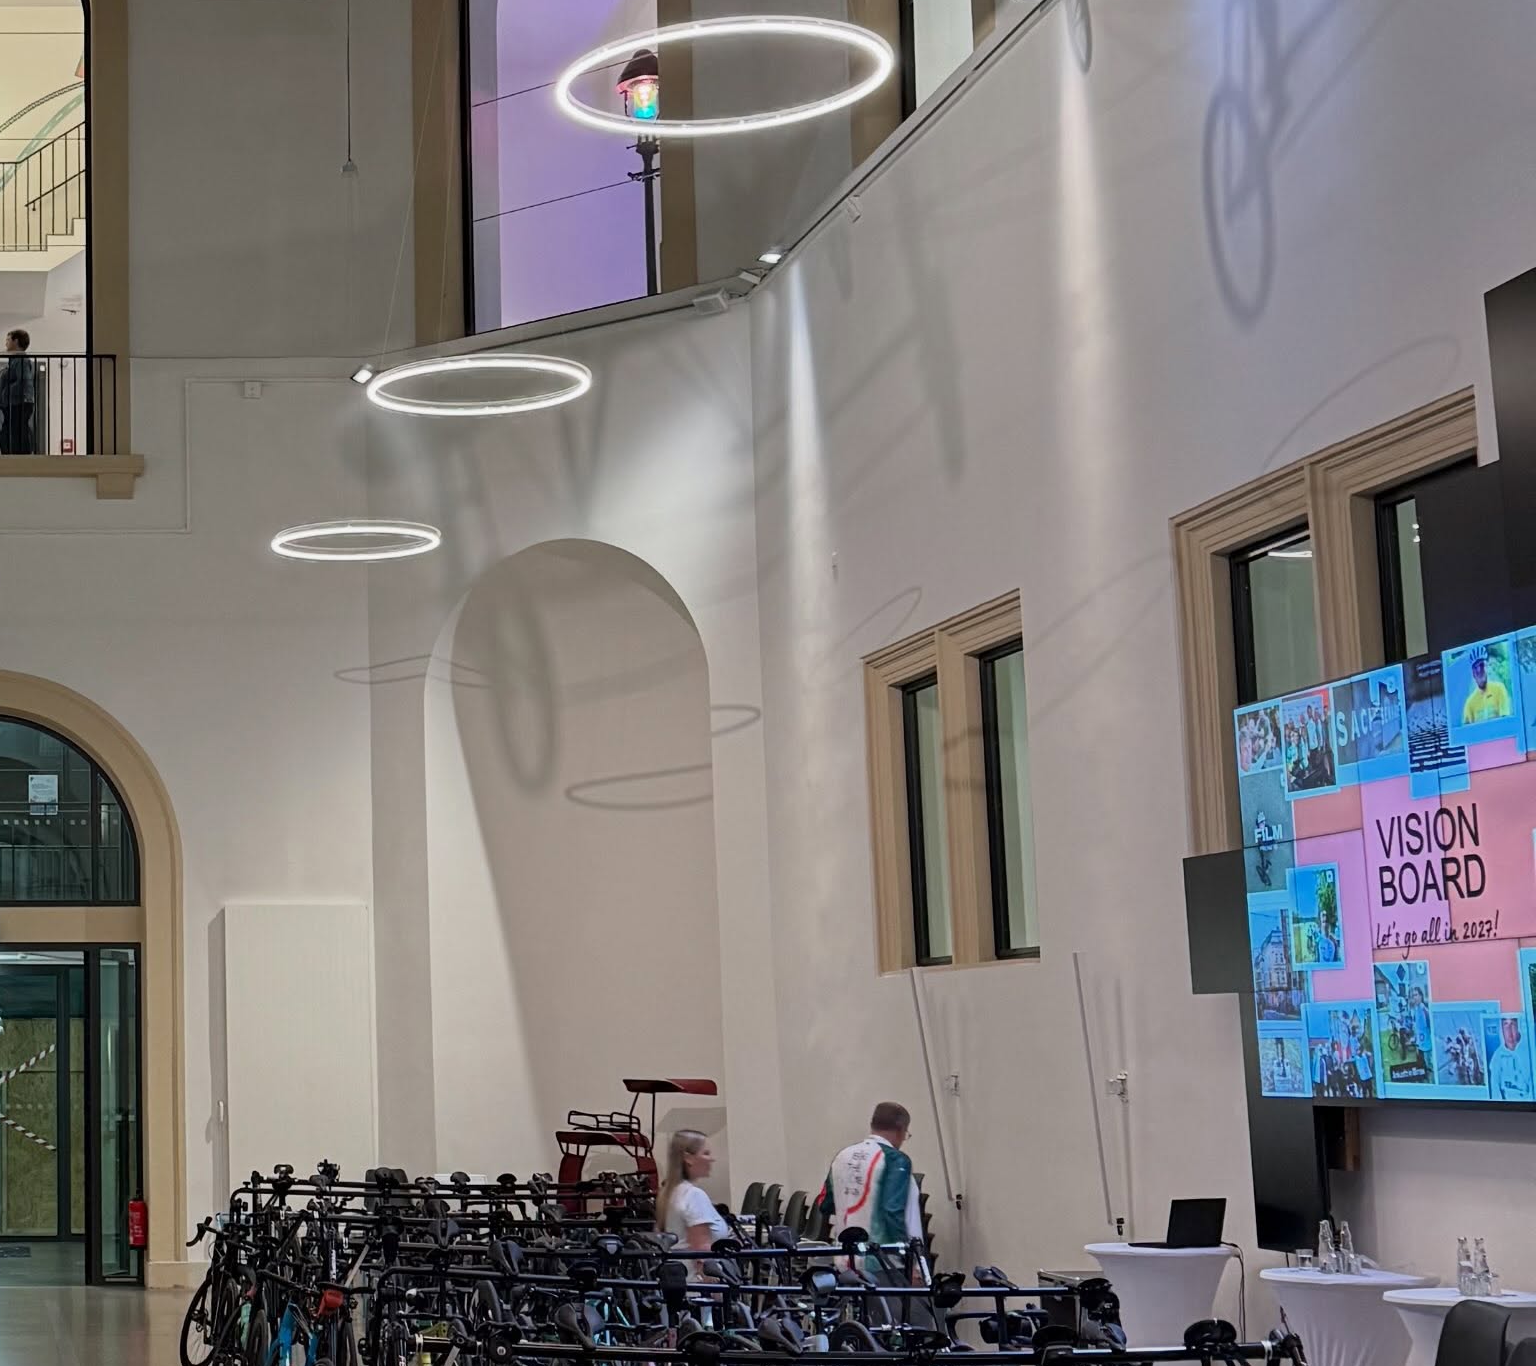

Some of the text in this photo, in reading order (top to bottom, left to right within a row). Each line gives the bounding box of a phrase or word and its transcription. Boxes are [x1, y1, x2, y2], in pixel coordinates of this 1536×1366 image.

[1254, 823, 1283, 843] FILM
[1375, 803, 1480, 859] VISION
[1378, 853, 1486, 907] BOARD
[1376, 909, 1500, 959] Let's go all in 2027!
